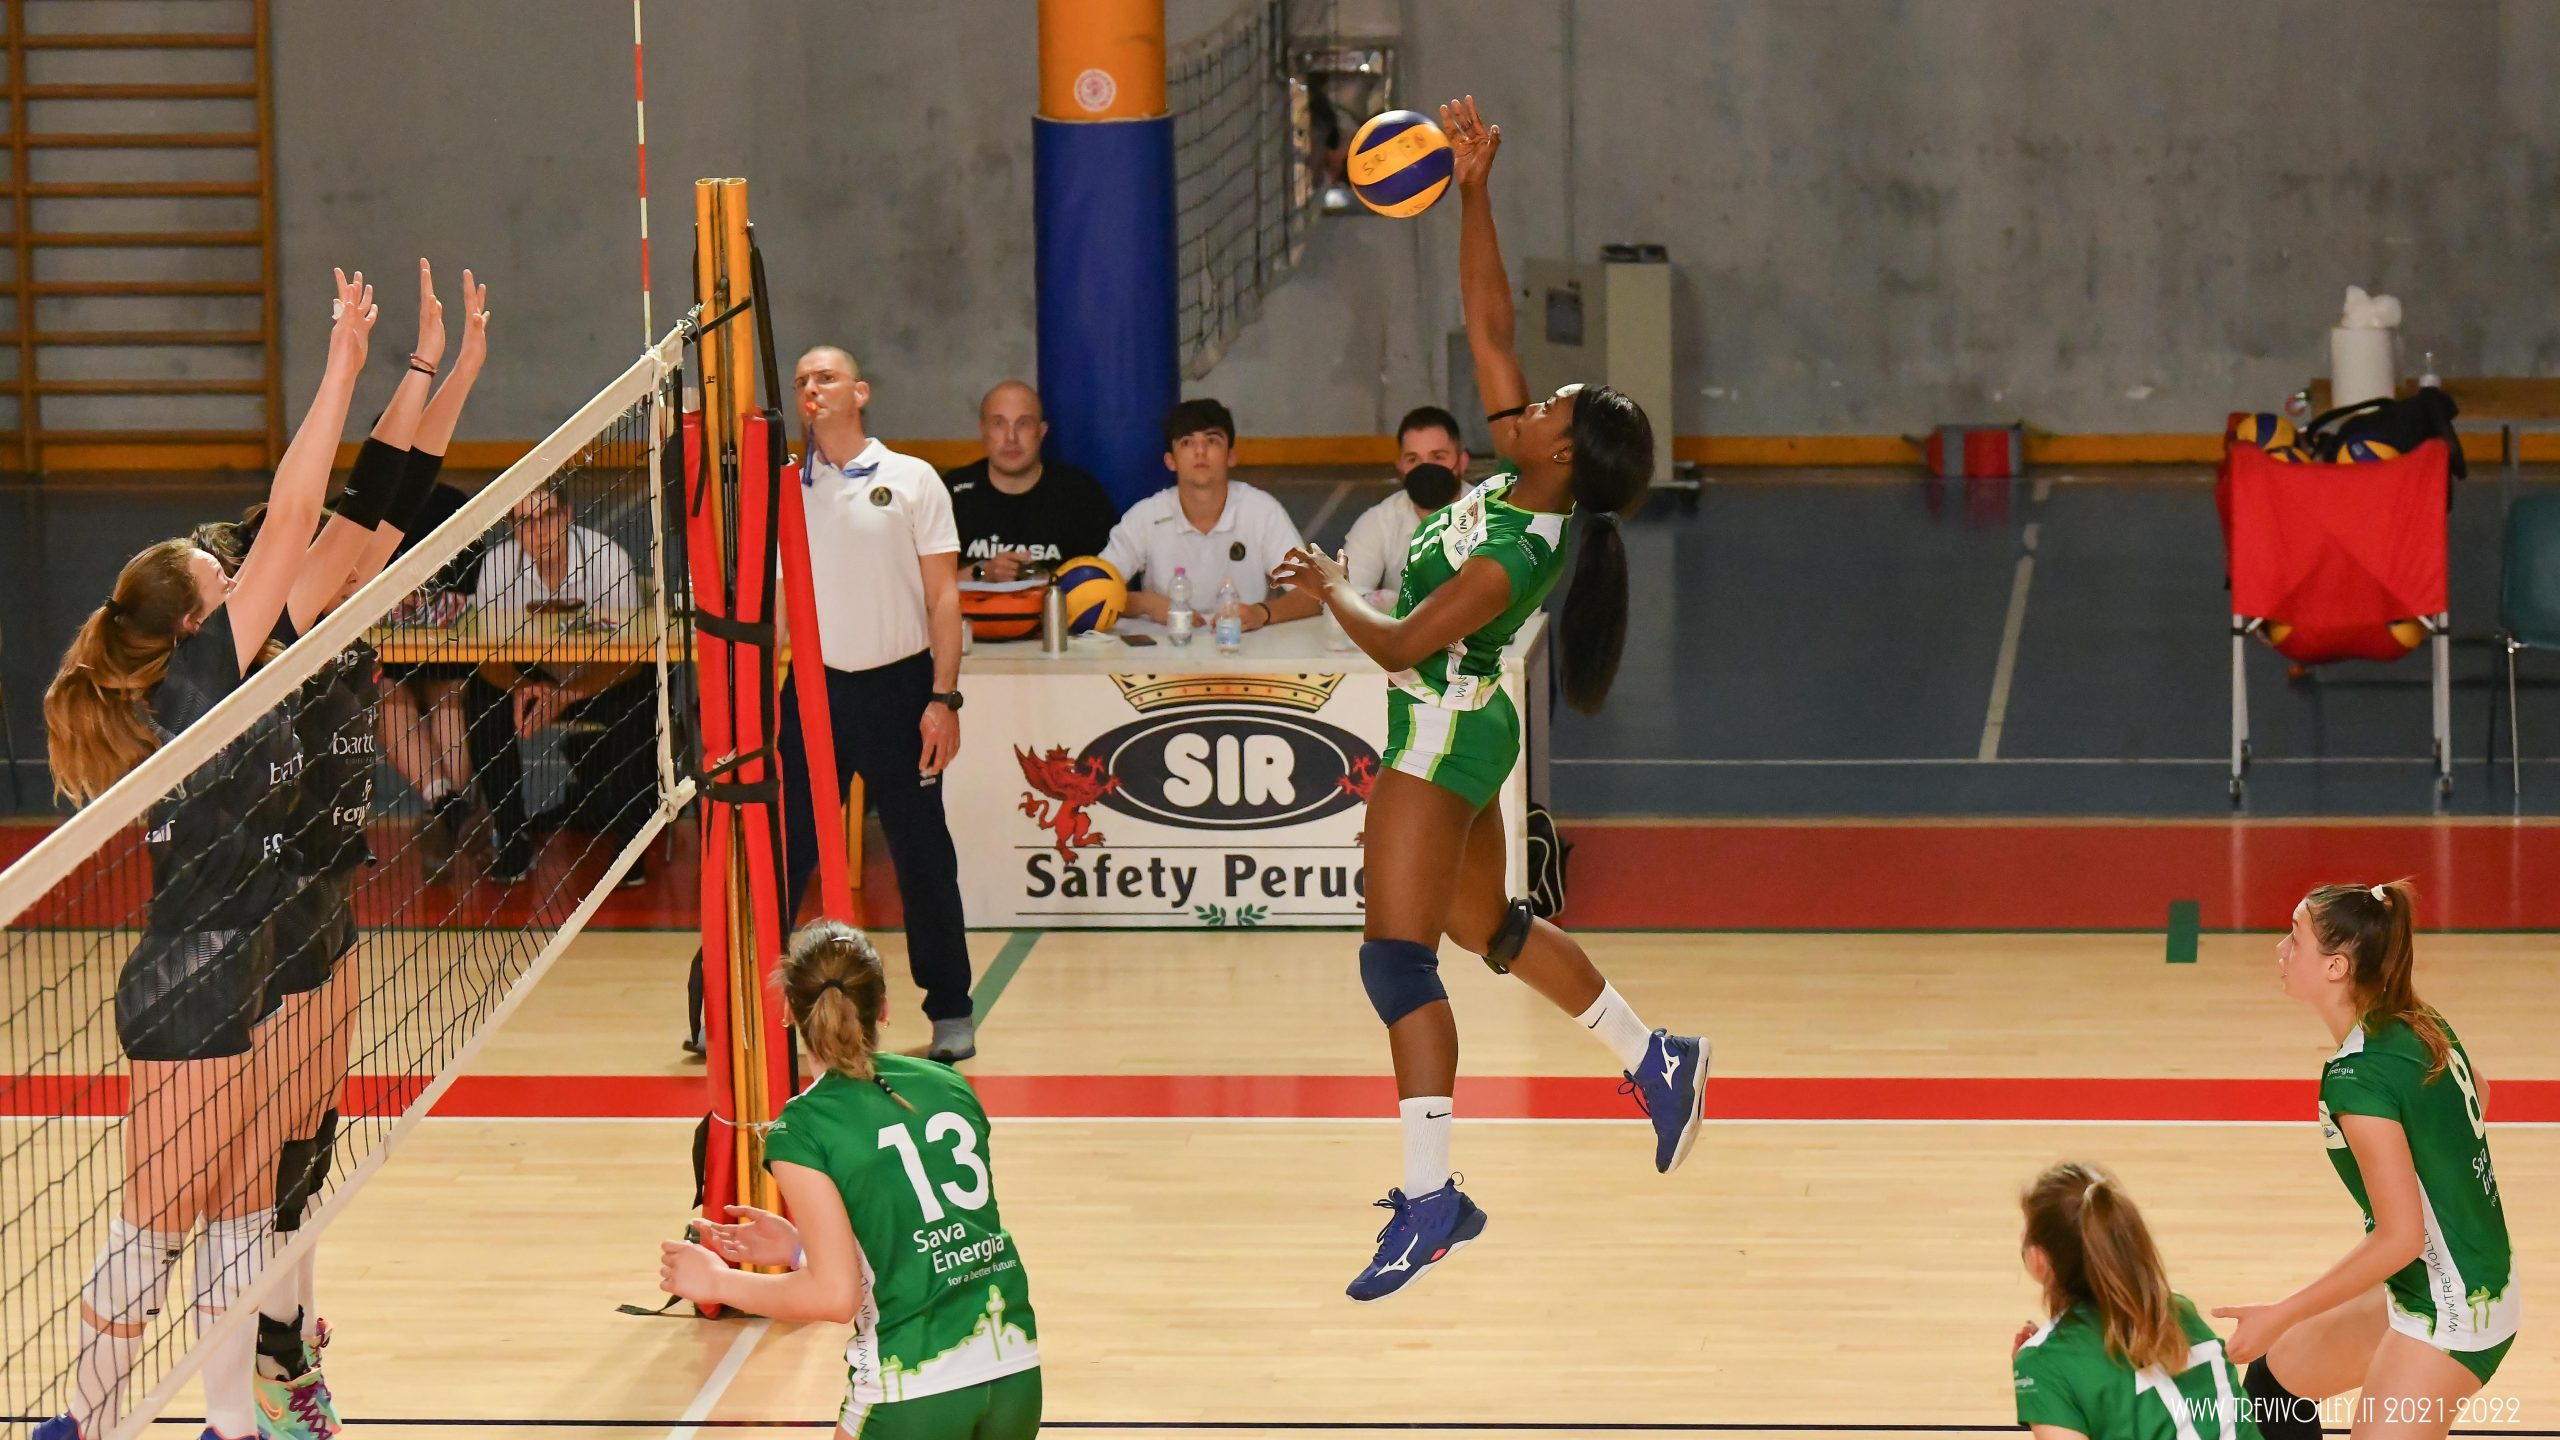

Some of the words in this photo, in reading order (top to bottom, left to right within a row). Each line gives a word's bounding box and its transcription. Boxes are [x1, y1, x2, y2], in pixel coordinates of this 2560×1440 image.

[1163, 733, 1297, 807] SIR
[1026, 853, 1197, 908] Safety
[2447, 1047, 2485, 1140] 8
[878, 1112, 990, 1223] 13
[913, 1222, 966, 1253] Sava
[932, 1232, 1005, 1274] Energia
[947, 1276, 963, 1287] for
[963, 1274, 969, 1283] a
[969, 1267, 992, 1280] better
[992, 1259, 1017, 1273] future
